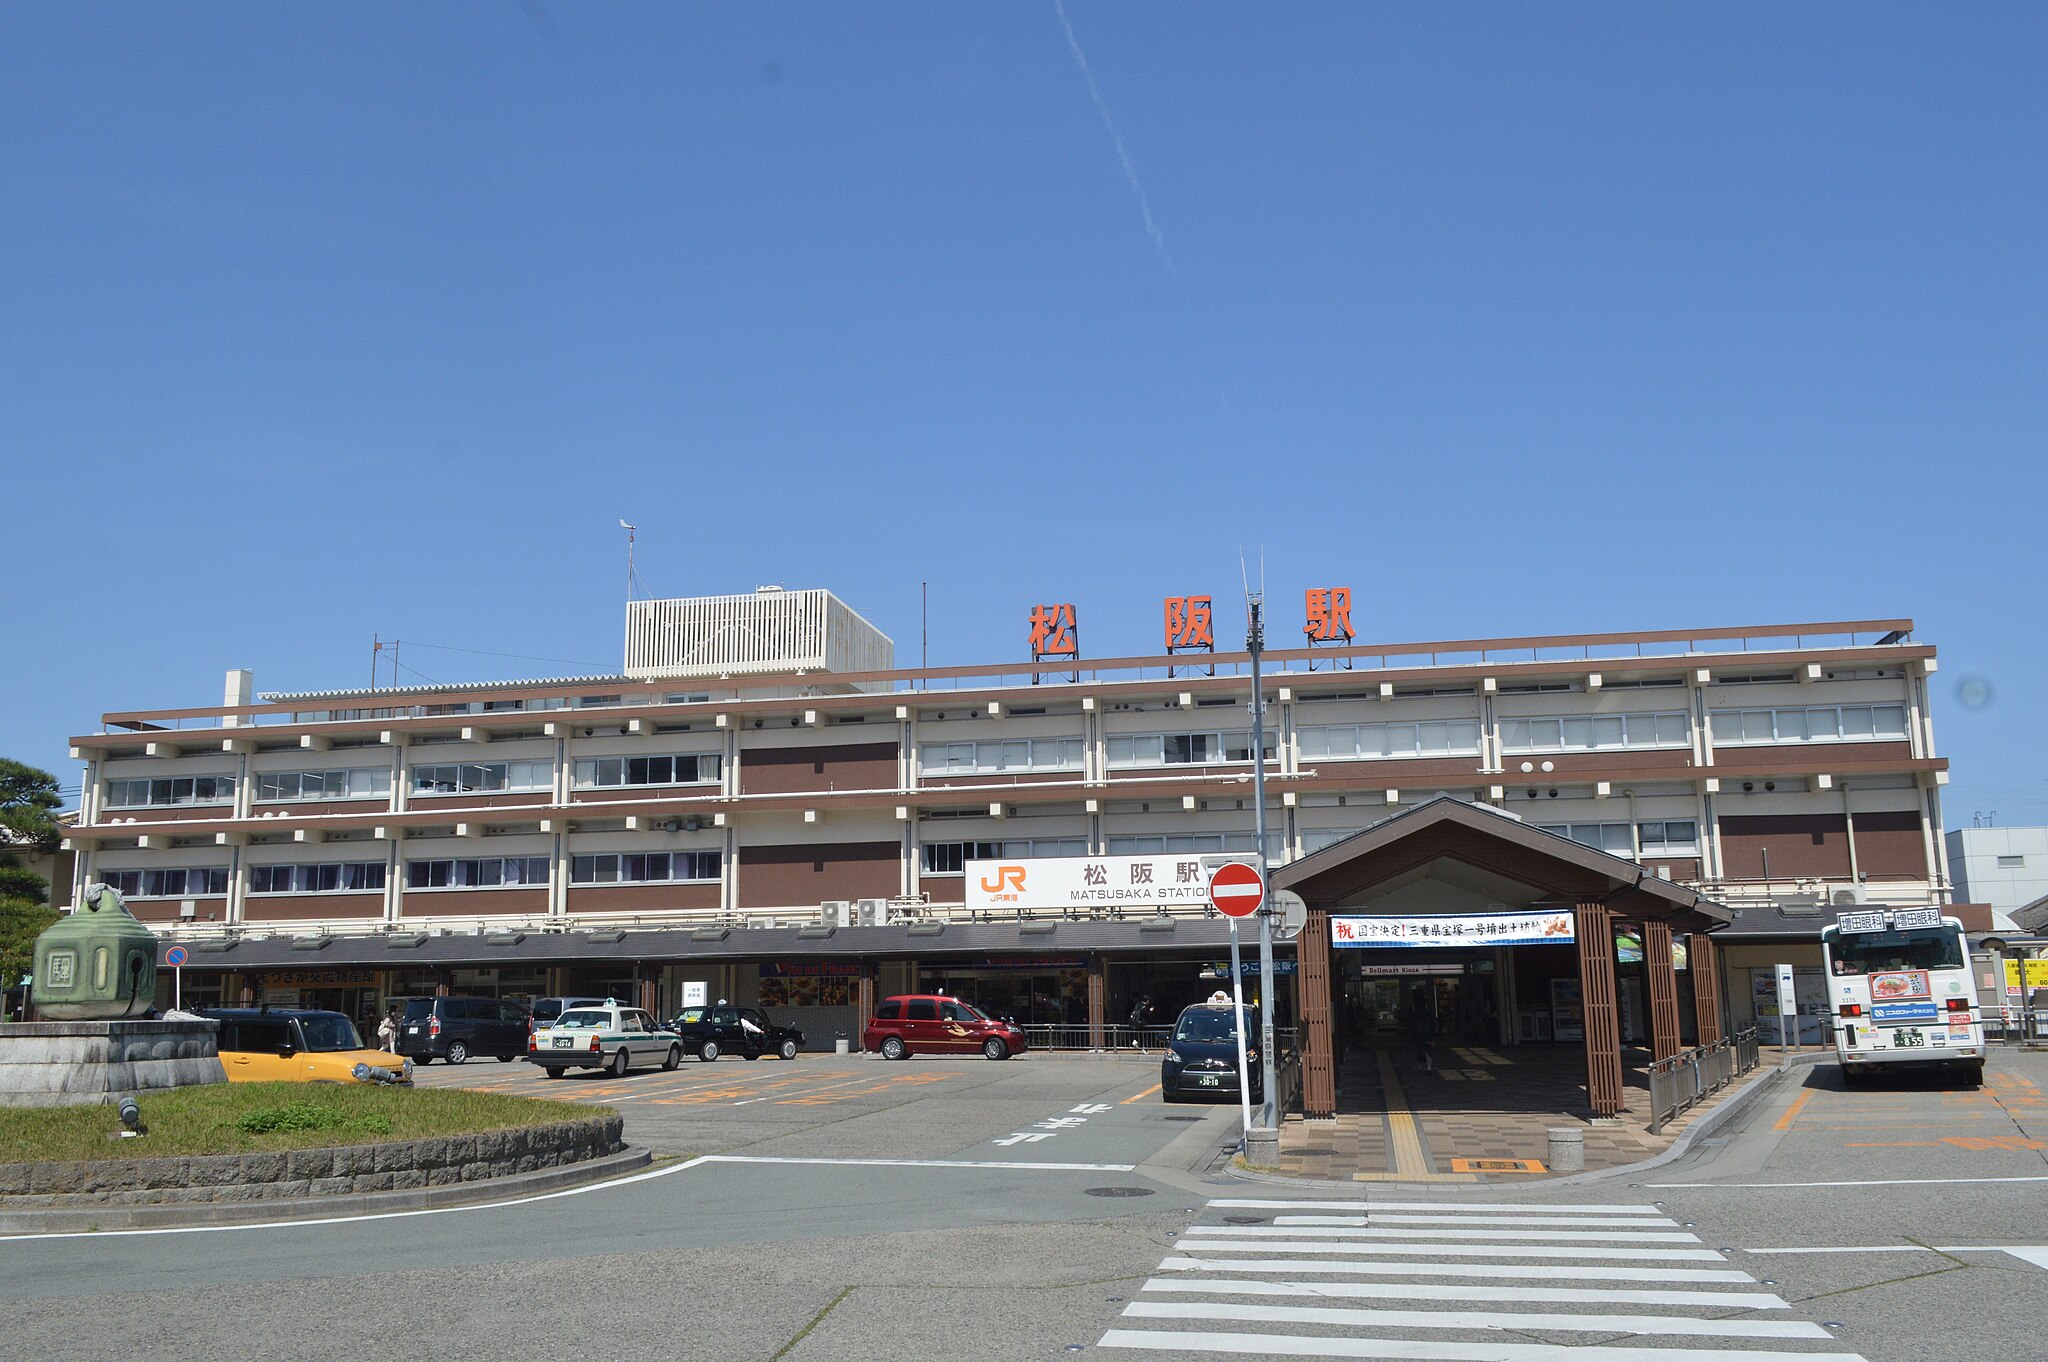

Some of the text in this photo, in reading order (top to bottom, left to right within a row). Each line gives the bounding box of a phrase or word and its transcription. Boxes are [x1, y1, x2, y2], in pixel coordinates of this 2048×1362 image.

[981, 866, 1027, 892] JR
[1084, 862, 1200, 885] 松阪駅
[1070, 889, 1152, 900] MATSUSAKA
[1841, 914, 1883, 931] 増田眼科
[1895, 911, 1939, 928] 増田眼科
